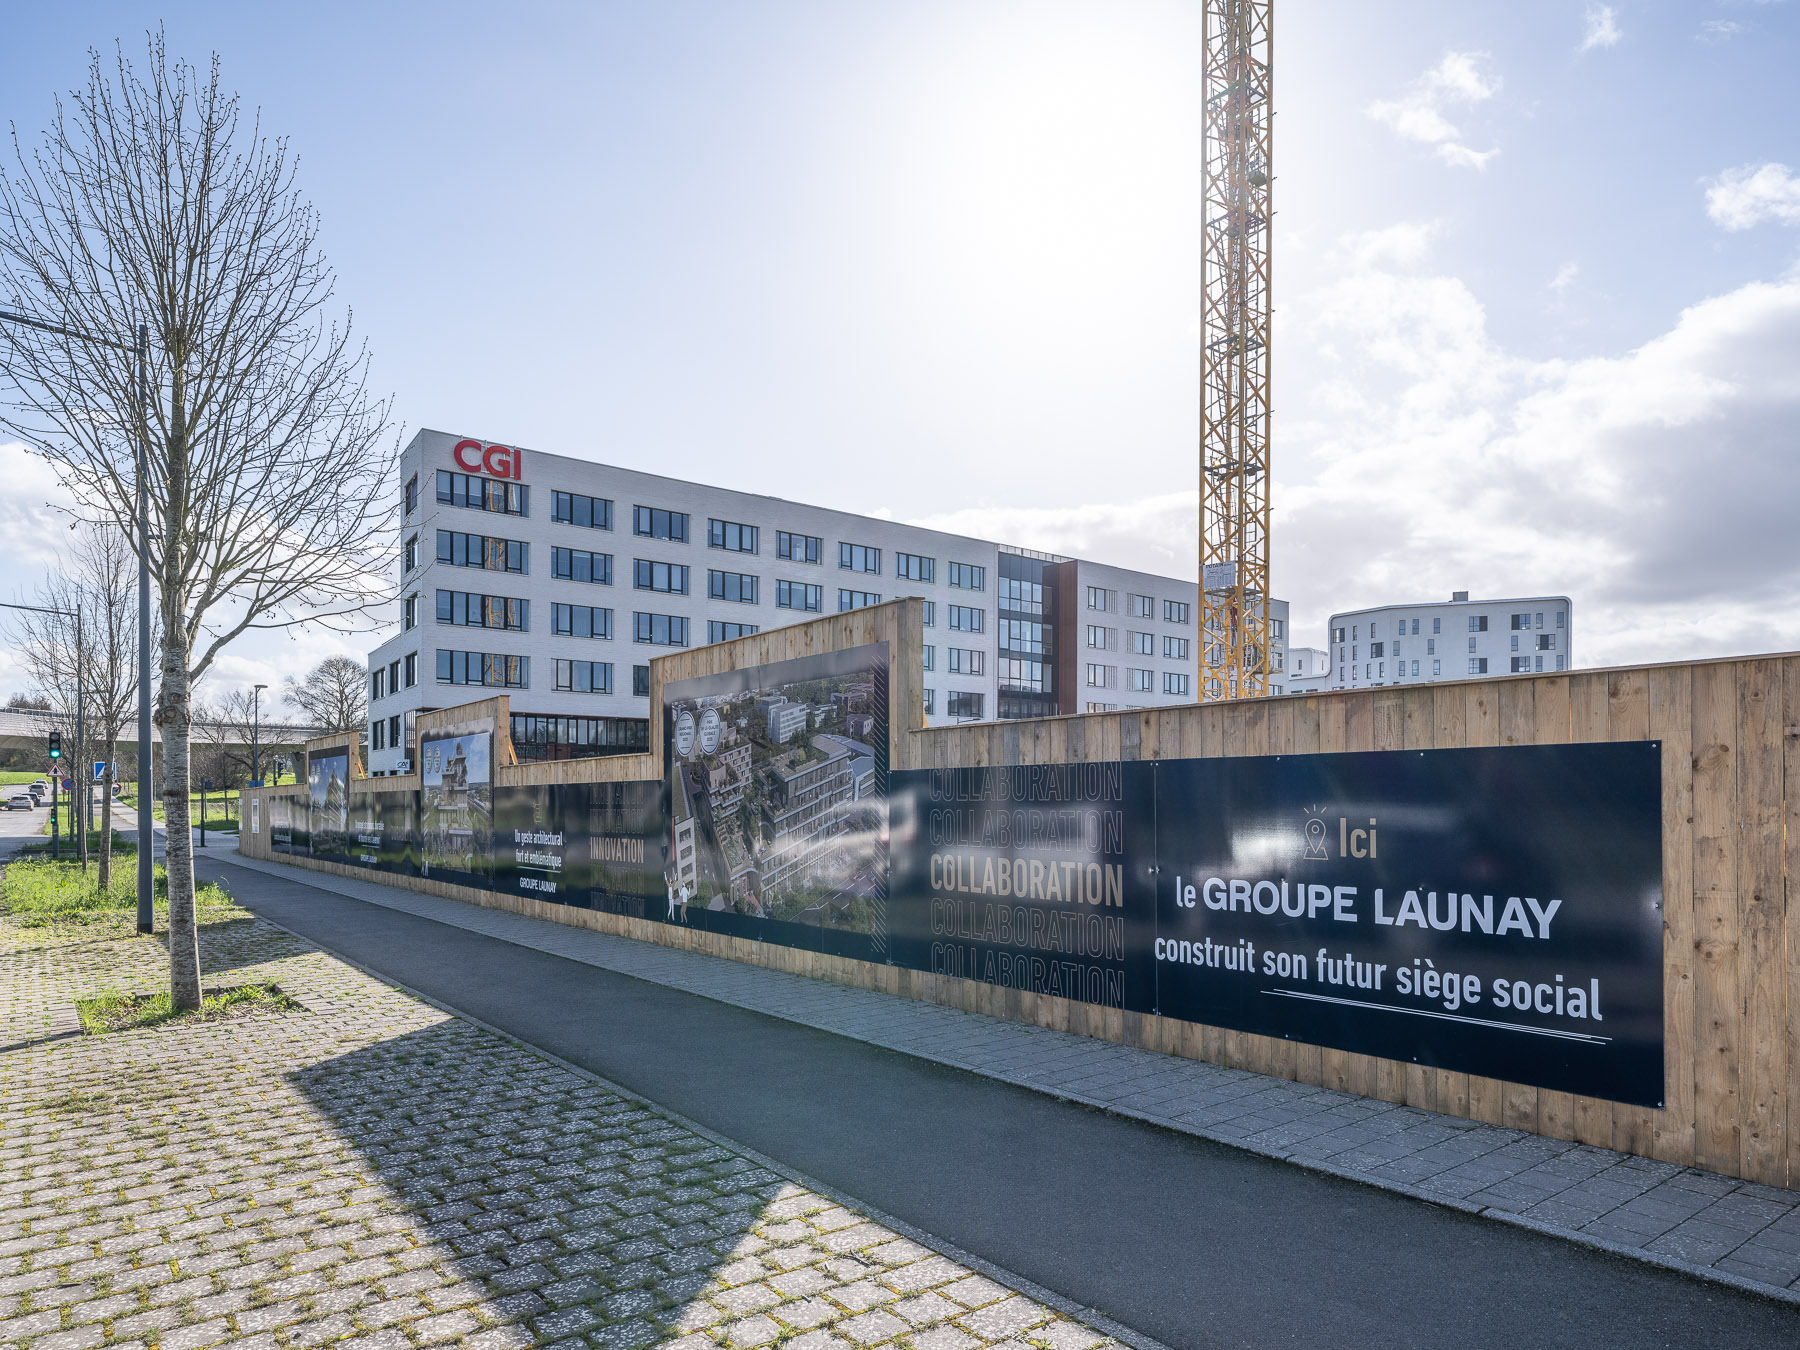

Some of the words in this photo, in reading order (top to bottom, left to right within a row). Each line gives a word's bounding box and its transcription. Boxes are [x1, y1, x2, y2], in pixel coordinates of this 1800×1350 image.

[454, 440, 521, 480] CGI
[929, 761, 1122, 801] COLLABORATION
[521, 831, 533, 846] geste
[534, 830, 563, 846] architectural
[590, 837, 644, 863] INNOVATION
[930, 809, 1123, 854] COLLABORATION
[1339, 817, 1377, 858] Ici
[524, 850, 529, 863] et
[520, 877, 538, 890] GROUPE
[539, 880, 557, 893] LAUNAY
[930, 854, 1123, 907] COLLABORATION
[1176, 876, 1196, 908] le
[1203, 877, 1358, 922] GROUPE
[1375, 888, 1562, 939] LAUNAY
[931, 898, 1125, 961] COLLABORATION
[931, 942, 1125, 1010] COLLABORATION
[1154, 936, 1255, 973] construit
[1263, 949, 1307, 979] son
[1316, 948, 1387, 990] futur
[1396, 958, 1481, 1010] siège
[1492, 974, 1603, 1020] social
